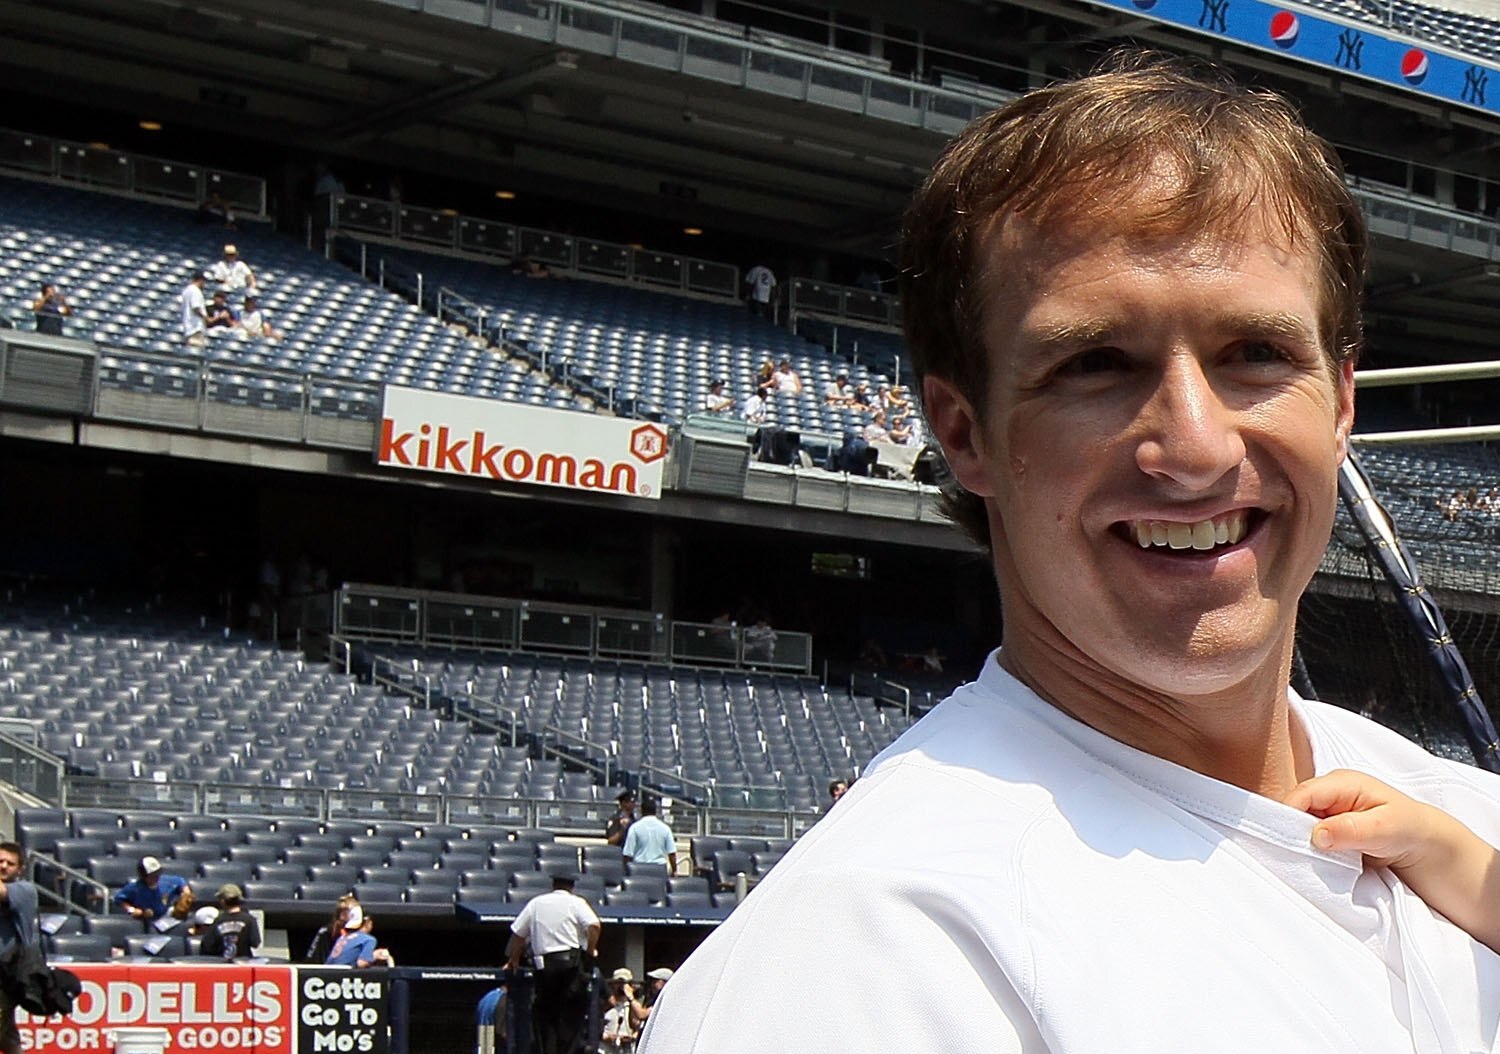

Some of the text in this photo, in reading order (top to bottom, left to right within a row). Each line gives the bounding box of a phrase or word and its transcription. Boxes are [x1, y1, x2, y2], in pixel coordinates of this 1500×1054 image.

[379, 418, 637, 494] kikkoman
[303, 977, 382, 1001] Gotta
[301, 1003, 378, 1026] Go To
[178, 1027, 282, 1049] GOODS
[313, 1030, 374, 1052] Mo's
